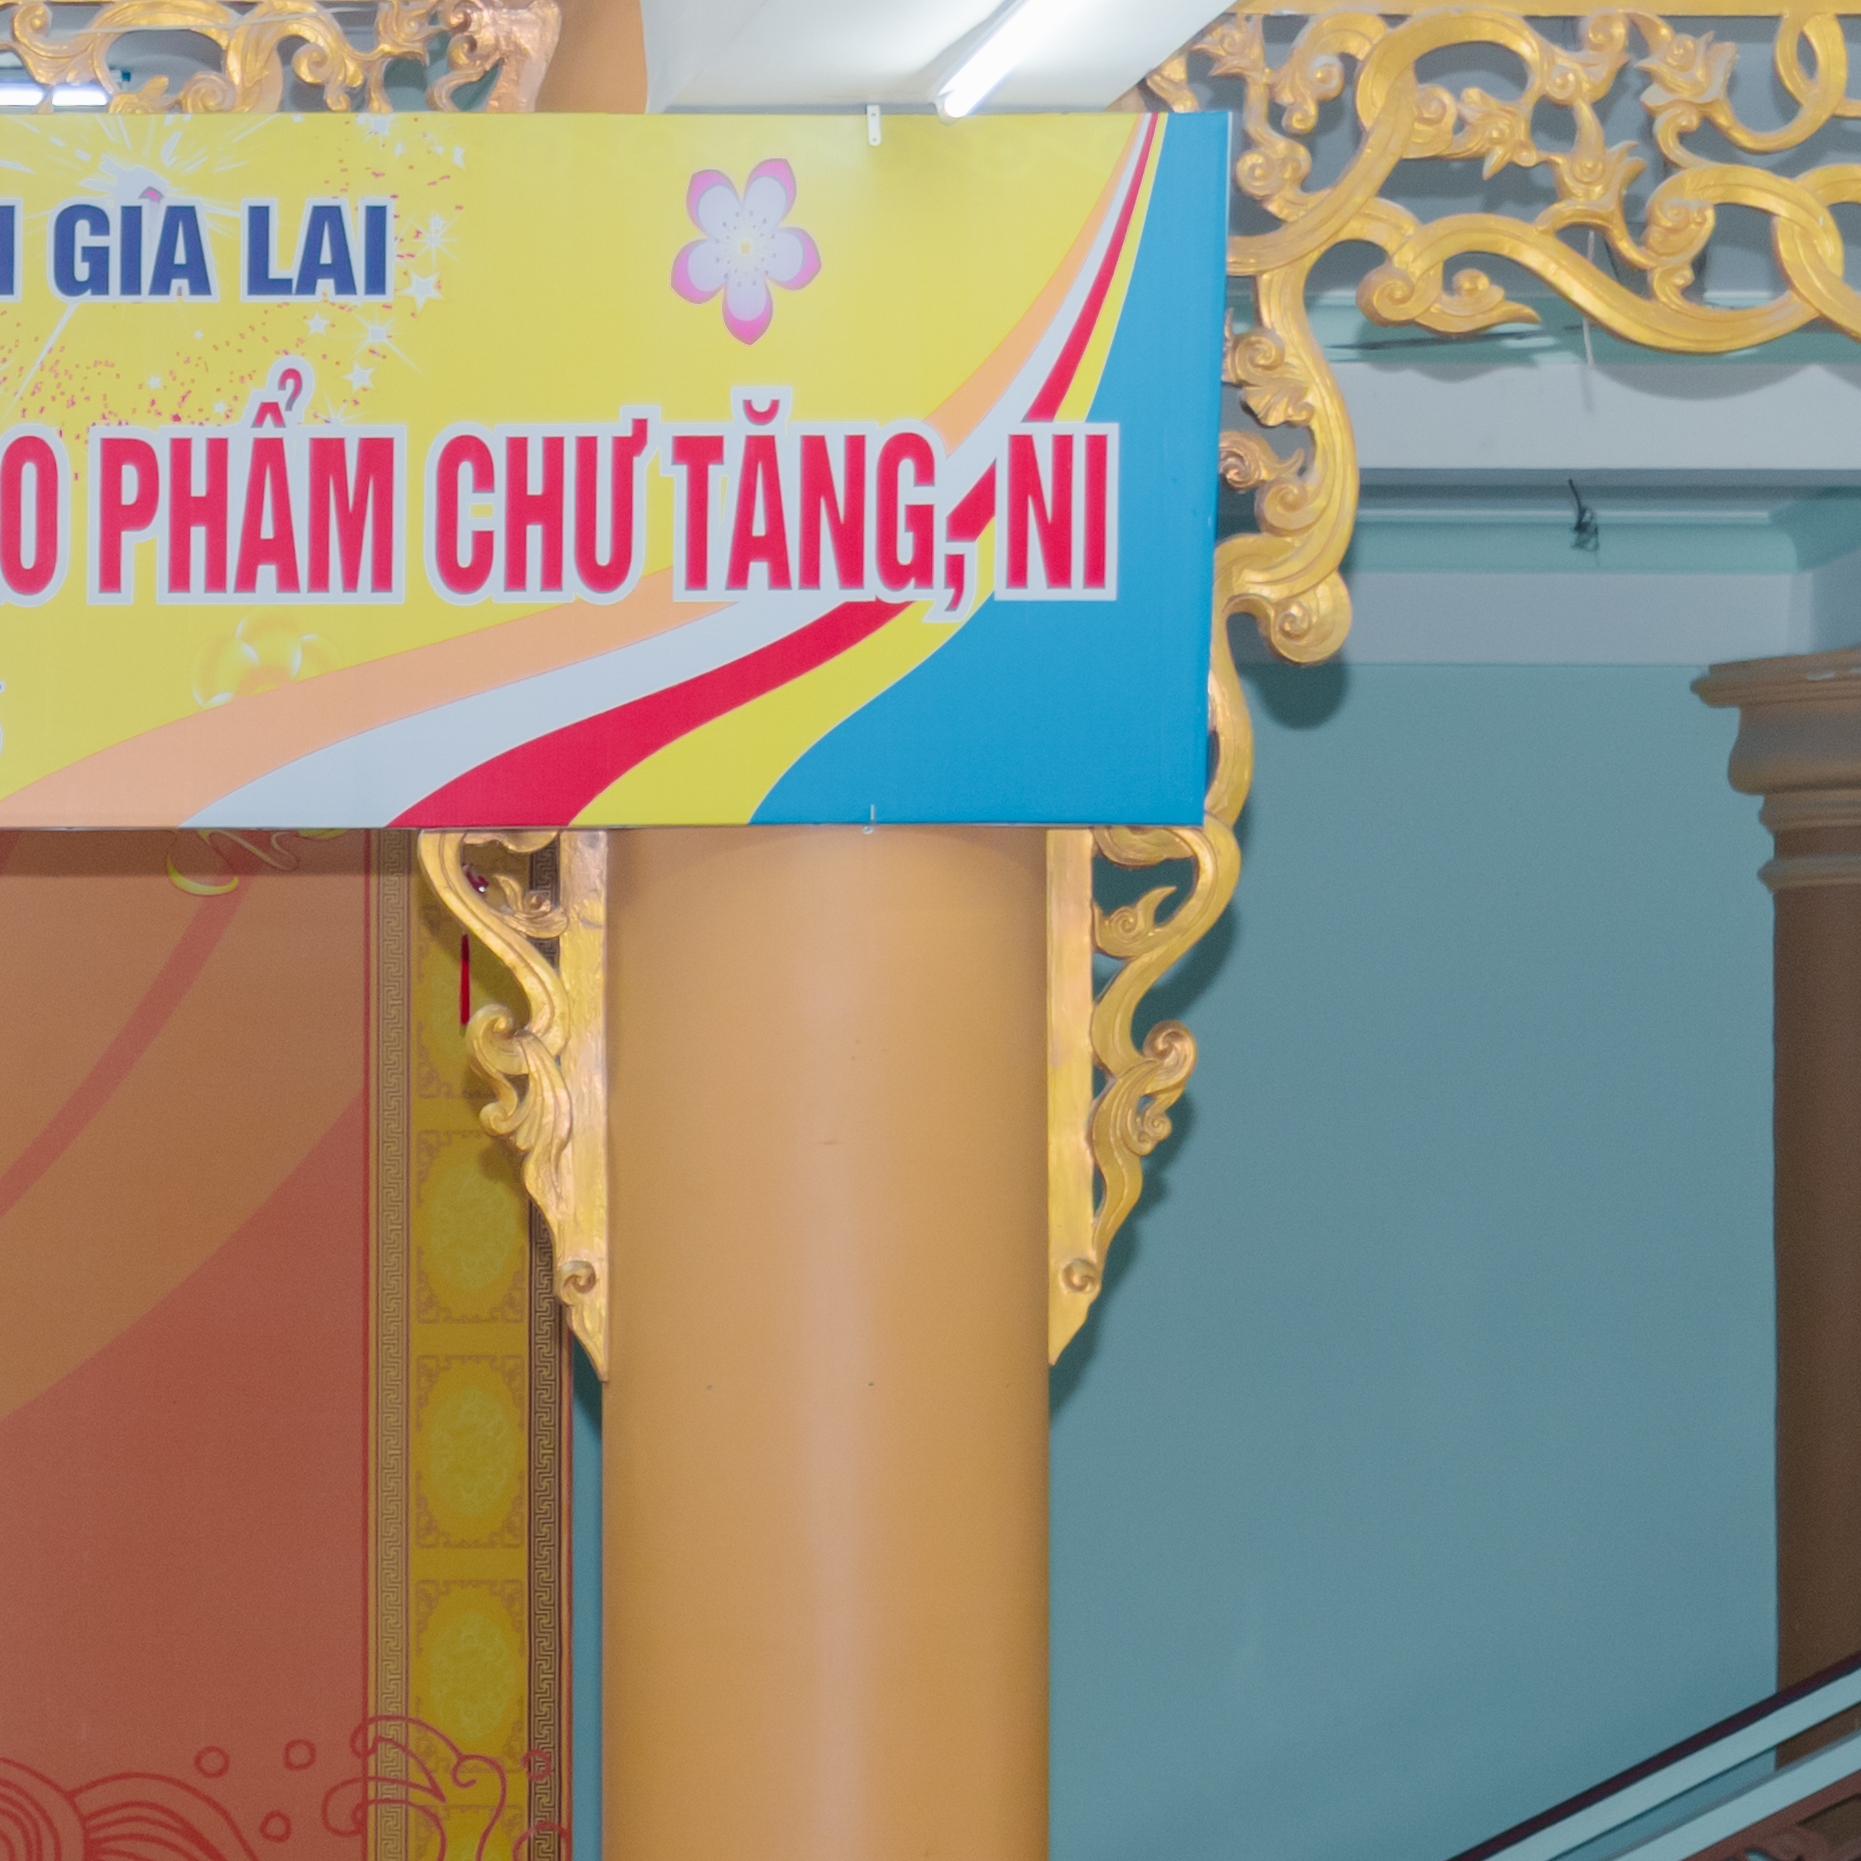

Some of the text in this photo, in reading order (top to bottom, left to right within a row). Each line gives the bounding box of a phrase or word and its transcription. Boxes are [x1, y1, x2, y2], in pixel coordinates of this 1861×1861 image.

[51, 203, 218, 297] GIA
[240, 203, 389, 297] LAI
[102, 367, 396, 595] PHẨM
[437, 415, 651, 595] CHƯ
[672, 397, 972, 613] TĂNG,
[1005, 431, 1111, 591] NI
